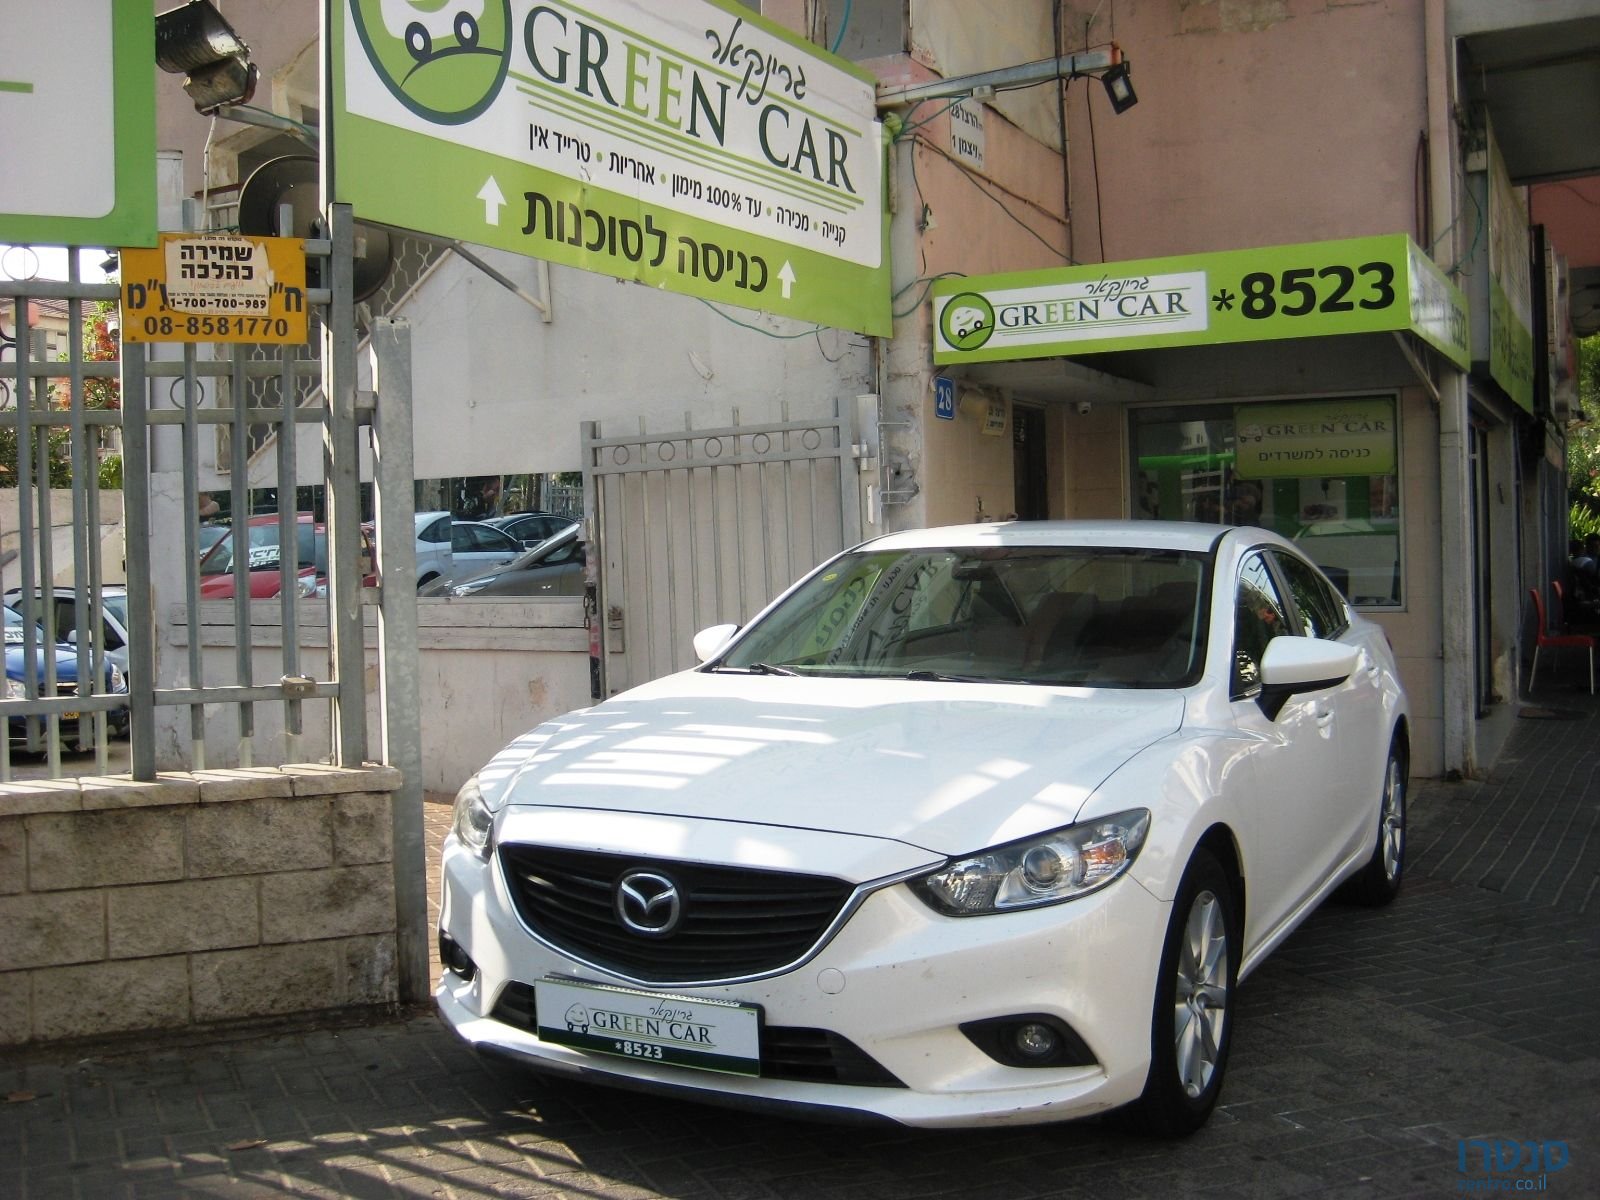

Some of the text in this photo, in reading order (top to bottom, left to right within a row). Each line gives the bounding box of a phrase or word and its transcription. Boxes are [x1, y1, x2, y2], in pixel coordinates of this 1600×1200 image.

[706, 18, 805, 105] גרינקאר
[524, 6, 856, 194] GREEN CAR
[529, 123, 846, 247] קנייה מכירה עד 100% מימון אחריות טרייד אין
[181, 245, 253, 261] שמירה
[522, 192, 768, 293] כניסה לסוכנות
[181, 262, 254, 280] כהלכה
[1085, 274, 1149, 302] גרינקאר
[170, 298, 267, 309] 1-700-700-989
[1000, 292, 1188, 327] GREEN CAR
[144, 316, 288, 336] 08-8581770
[938, 386, 952, 411] 28
[1267, 421, 1386, 436] GREEN CAR
[1258, 447, 1370, 462] כניסה למשרדים
[649, 1000, 693, 1024] גרינקאר
[593, 1011, 713, 1044] GREEN CAR
